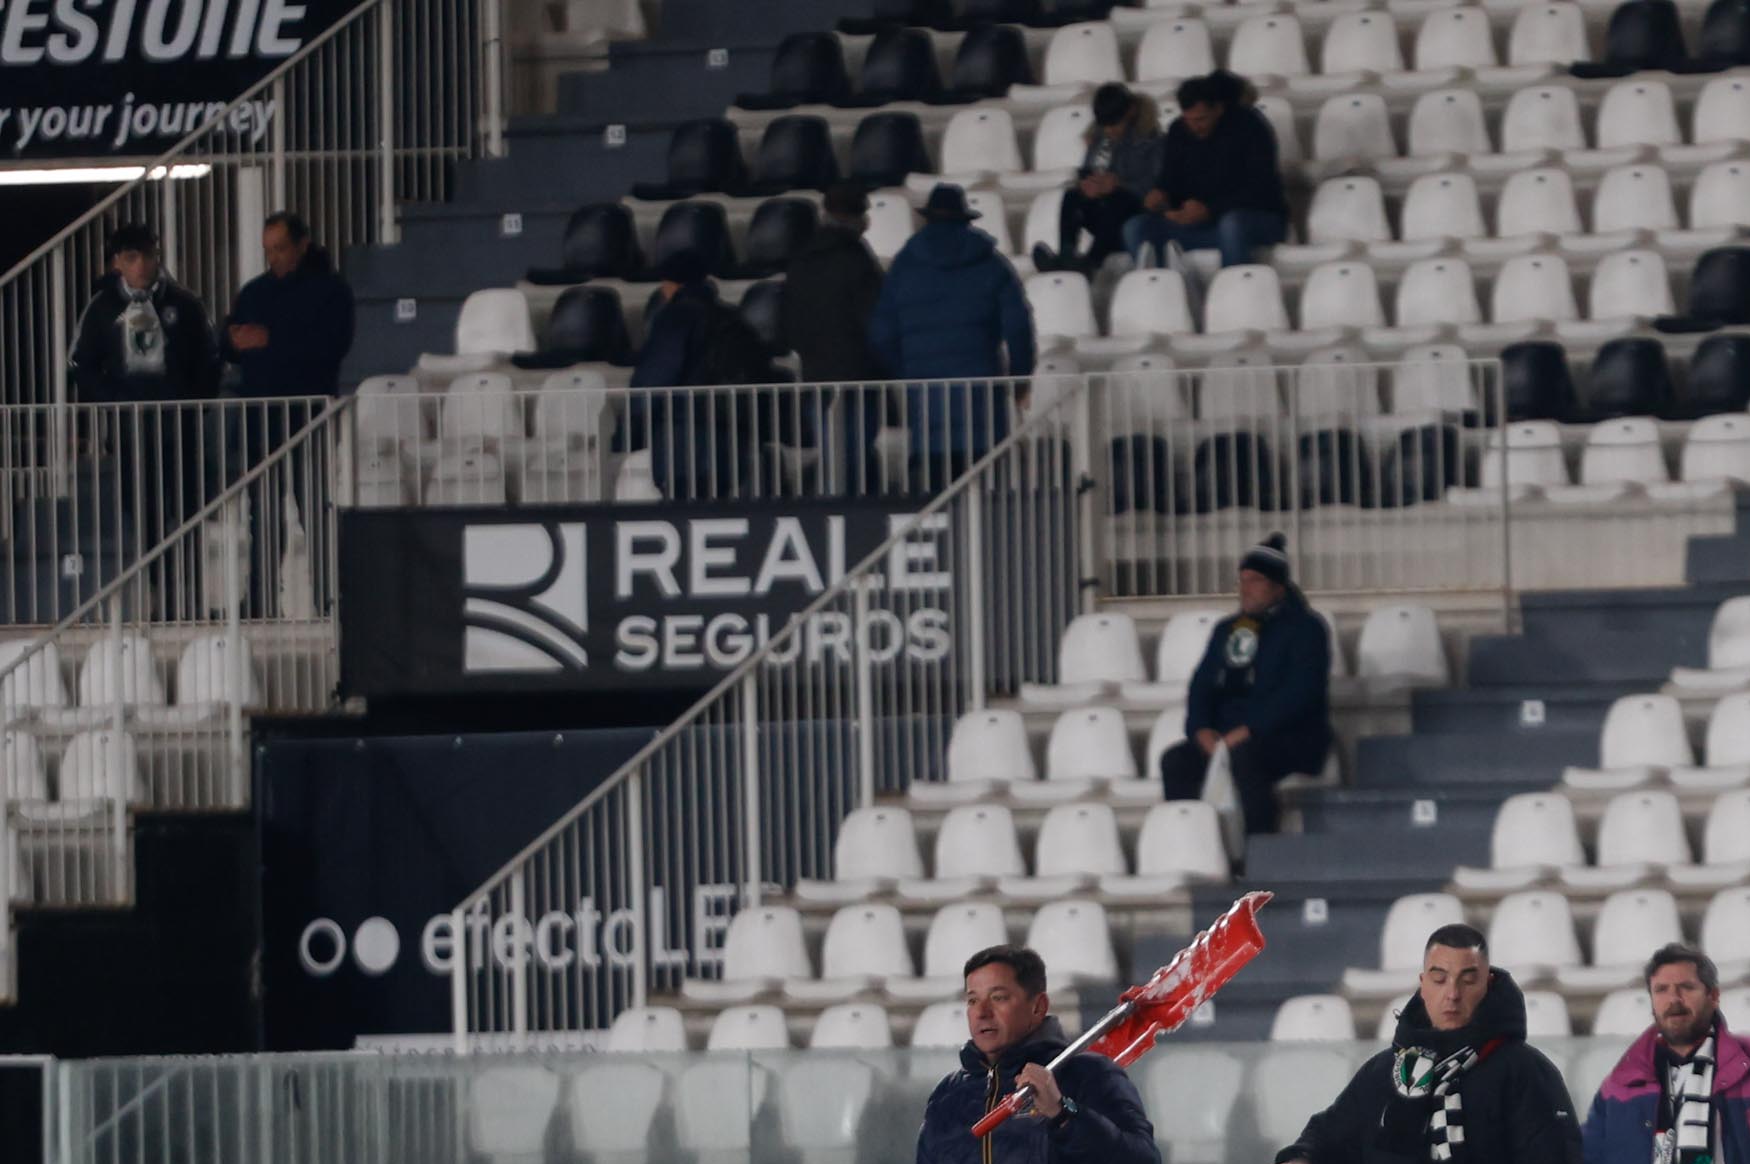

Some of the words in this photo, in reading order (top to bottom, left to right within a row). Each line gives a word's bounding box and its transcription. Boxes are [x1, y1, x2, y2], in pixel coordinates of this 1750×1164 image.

[0, 0, 306, 62] ESTONE
[15, 104, 112, 149] your
[112, 92, 275, 146] journey
[615, 513, 952, 598] REALE
[614, 608, 953, 670] SEGUROS
[420, 883, 783, 974] efectoLE
